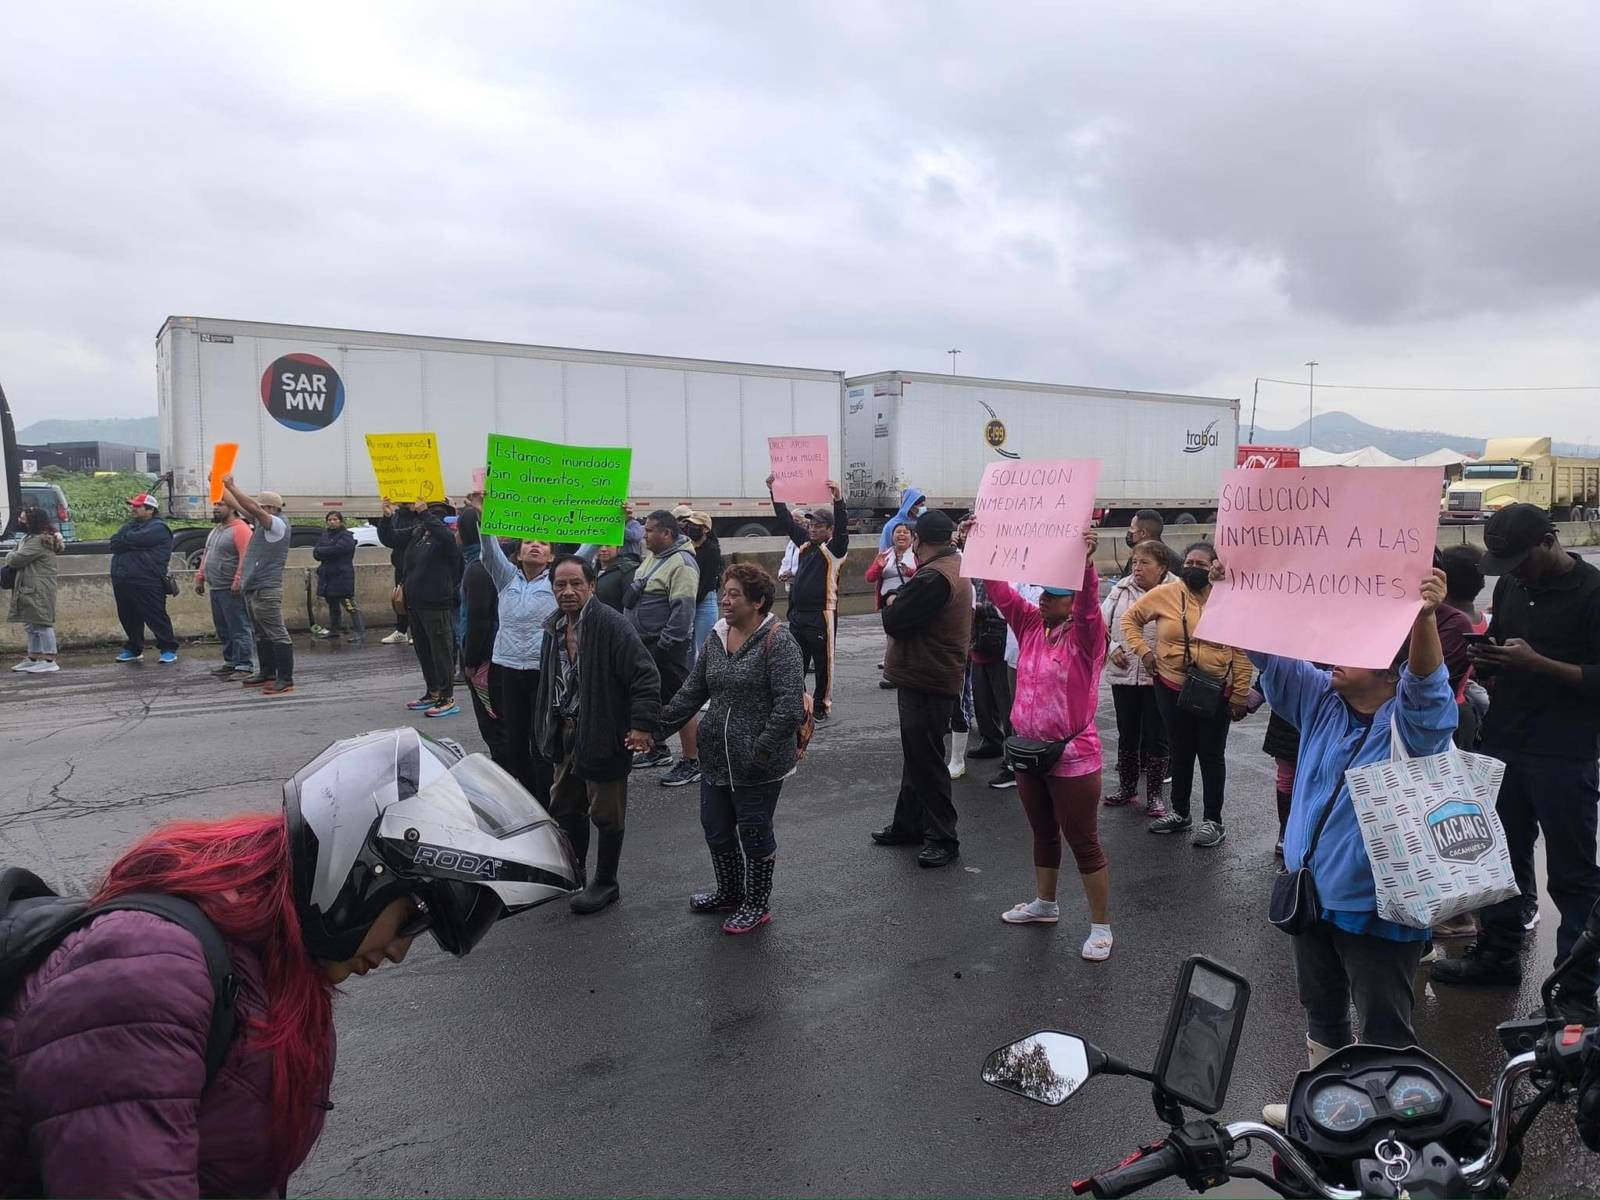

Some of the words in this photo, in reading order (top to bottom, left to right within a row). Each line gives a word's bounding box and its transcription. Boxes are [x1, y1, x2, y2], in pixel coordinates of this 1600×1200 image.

[281, 372, 327, 392] SAR
[285, 392, 326, 411] MW
[1187, 429, 1218, 447] trabal
[496, 441, 552, 465] Estamos
[562, 456, 620, 469] inundados
[520, 468, 585, 489] alimentos,
[592, 476, 611, 486] sin
[527, 494, 546, 504] con
[1054, 493, 1067, 510] A
[1222, 476, 1331, 512] SOLUCIÓN
[489, 508, 496, 519] y
[504, 508, 522, 518] sin
[578, 508, 621, 523] Tenemos
[484, 520, 549, 535] autoridades
[556, 525, 606, 536] ausentes
[996, 522, 1079, 538] INUNDACIONES
[1220, 525, 1330, 548] INMEDIATA
[1347, 526, 1362, 549] A
[1378, 527, 1421, 554] LAS
[1229, 568, 1407, 600] INUNDACIONES
[1433, 815, 1488, 850] KACANG
[413, 847, 497, 876] RODA
